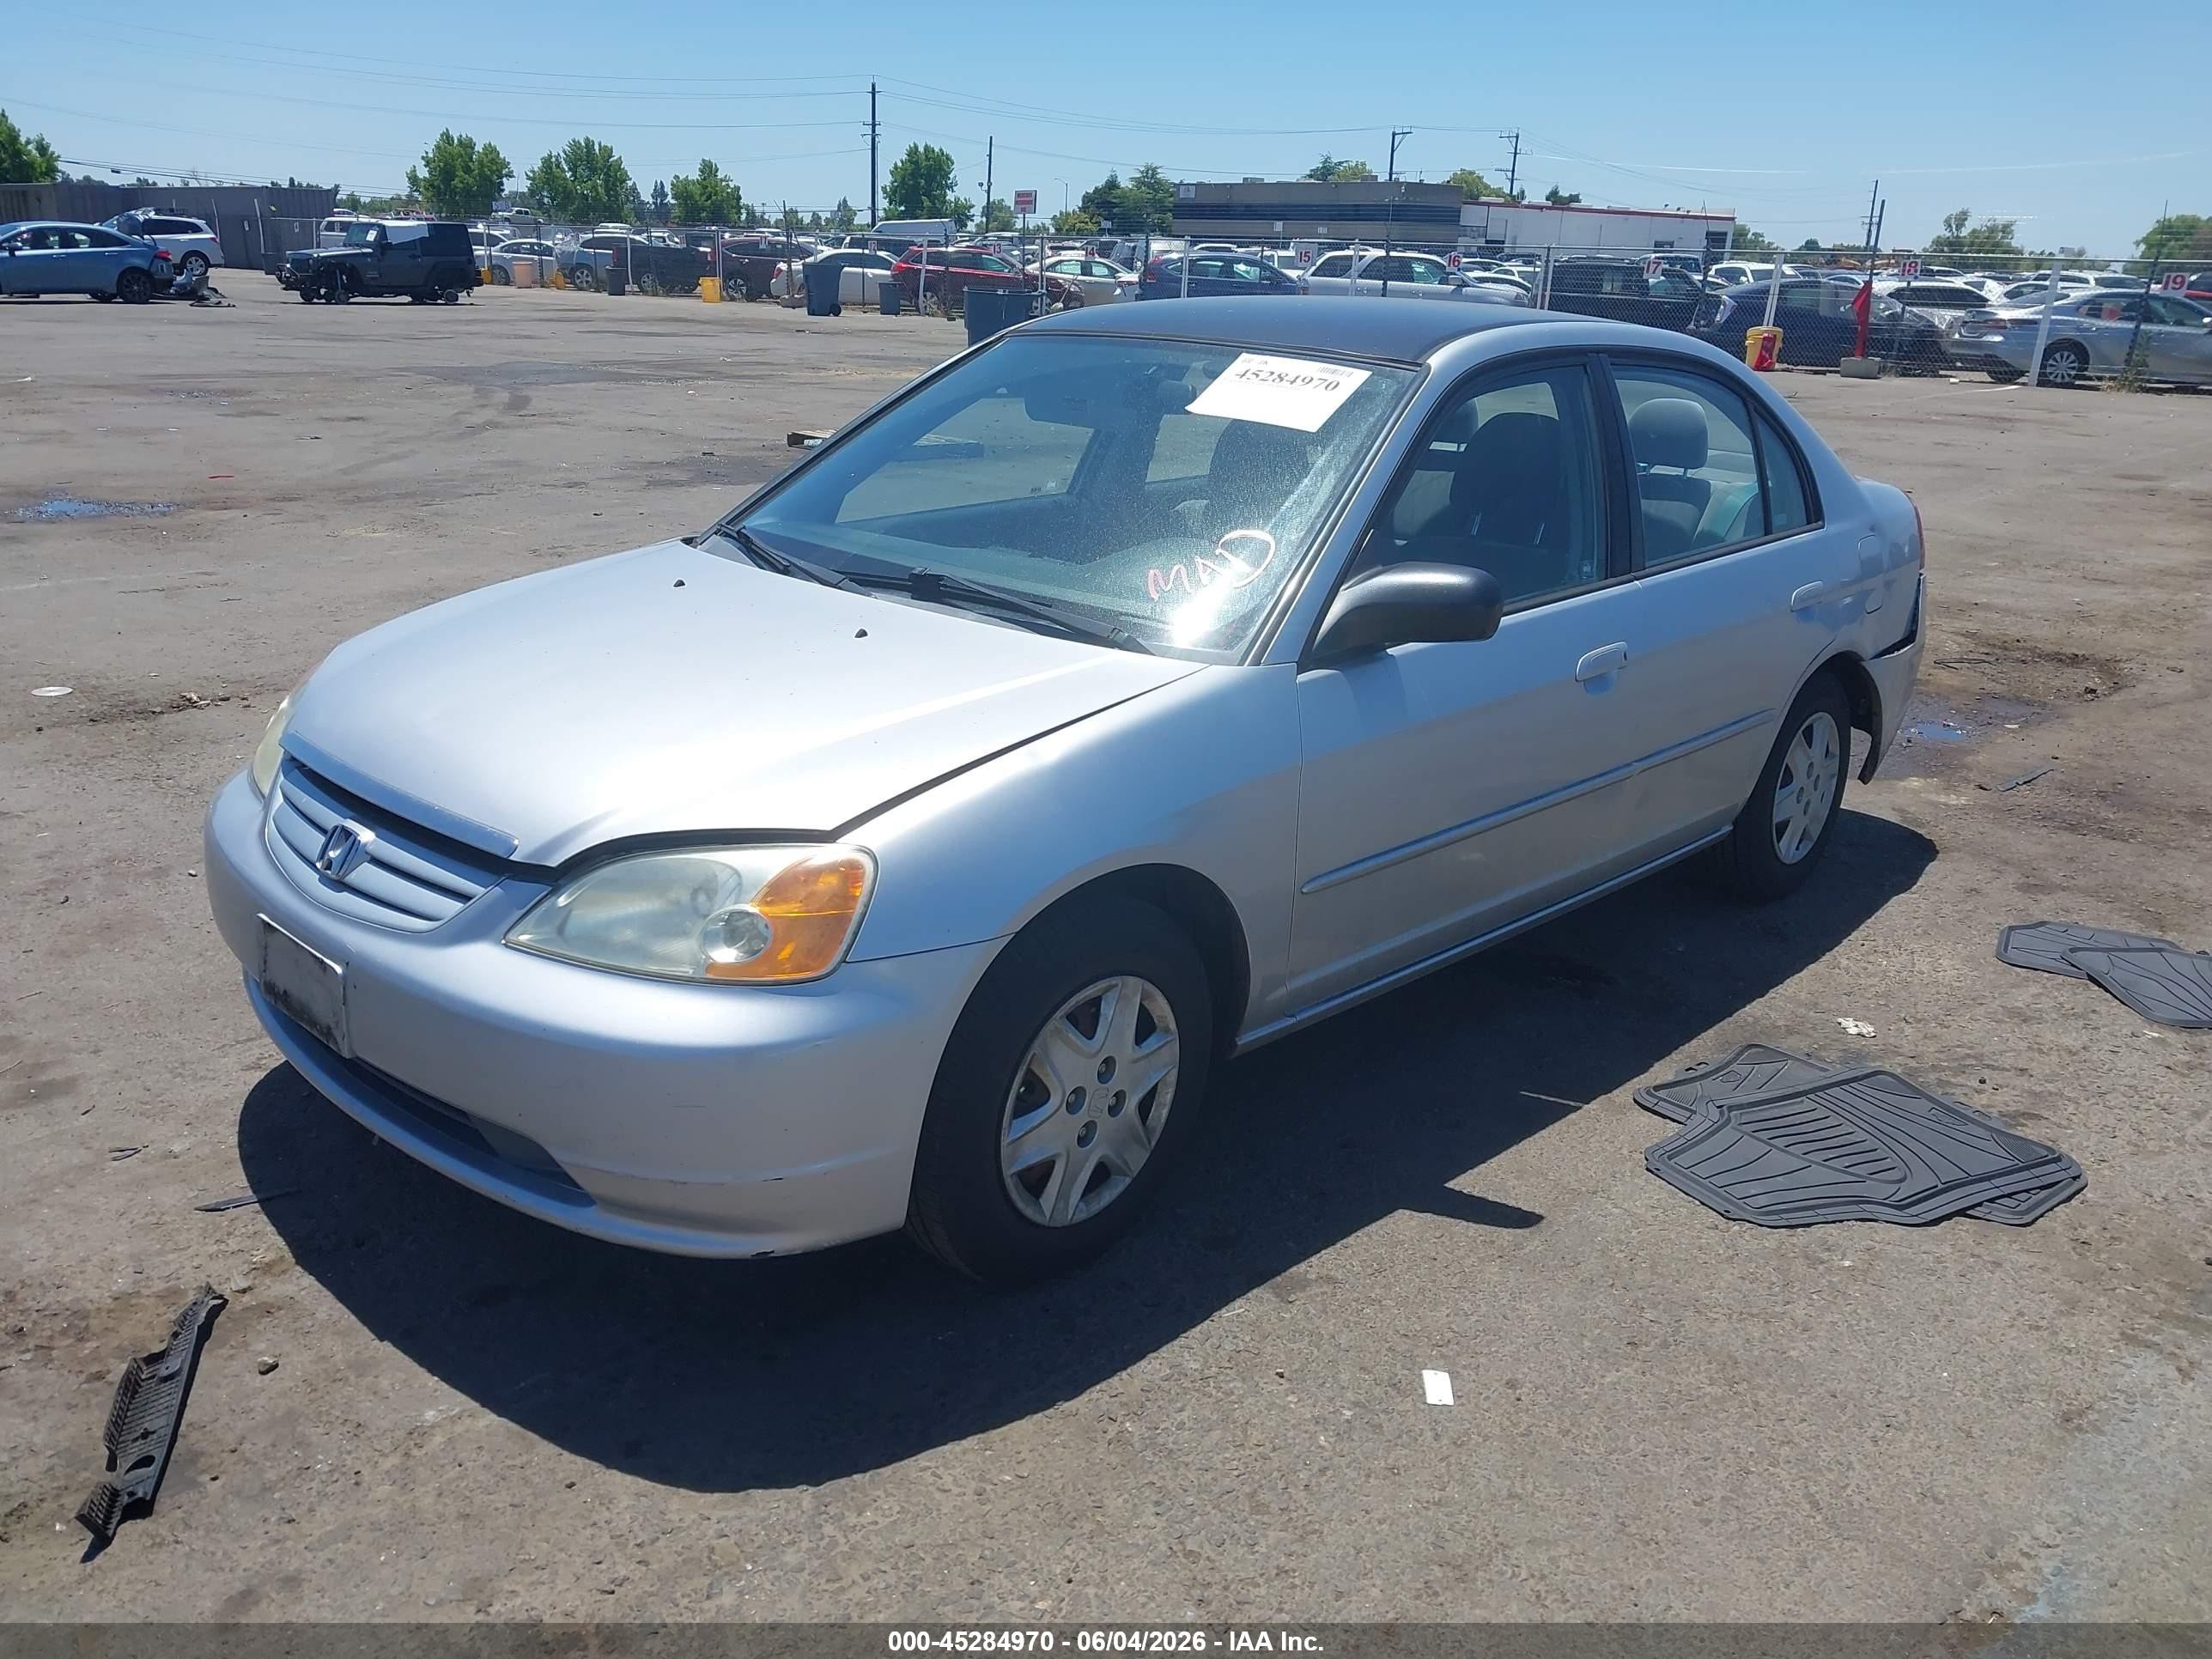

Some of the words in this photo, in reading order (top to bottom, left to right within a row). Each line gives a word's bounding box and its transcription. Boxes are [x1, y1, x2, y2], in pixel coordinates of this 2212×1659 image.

[993, 243, 1002, 254] 13
[1085, 246, 1096, 257] 14
[1299, 251, 1310, 263] 15
[1448, 254, 1461, 268] 16
[1645, 260, 1662, 275] 17
[1902, 261, 1918, 276] 18
[2163, 274, 2185, 290] 19
[1235, 368, 1340, 392] 45284970
